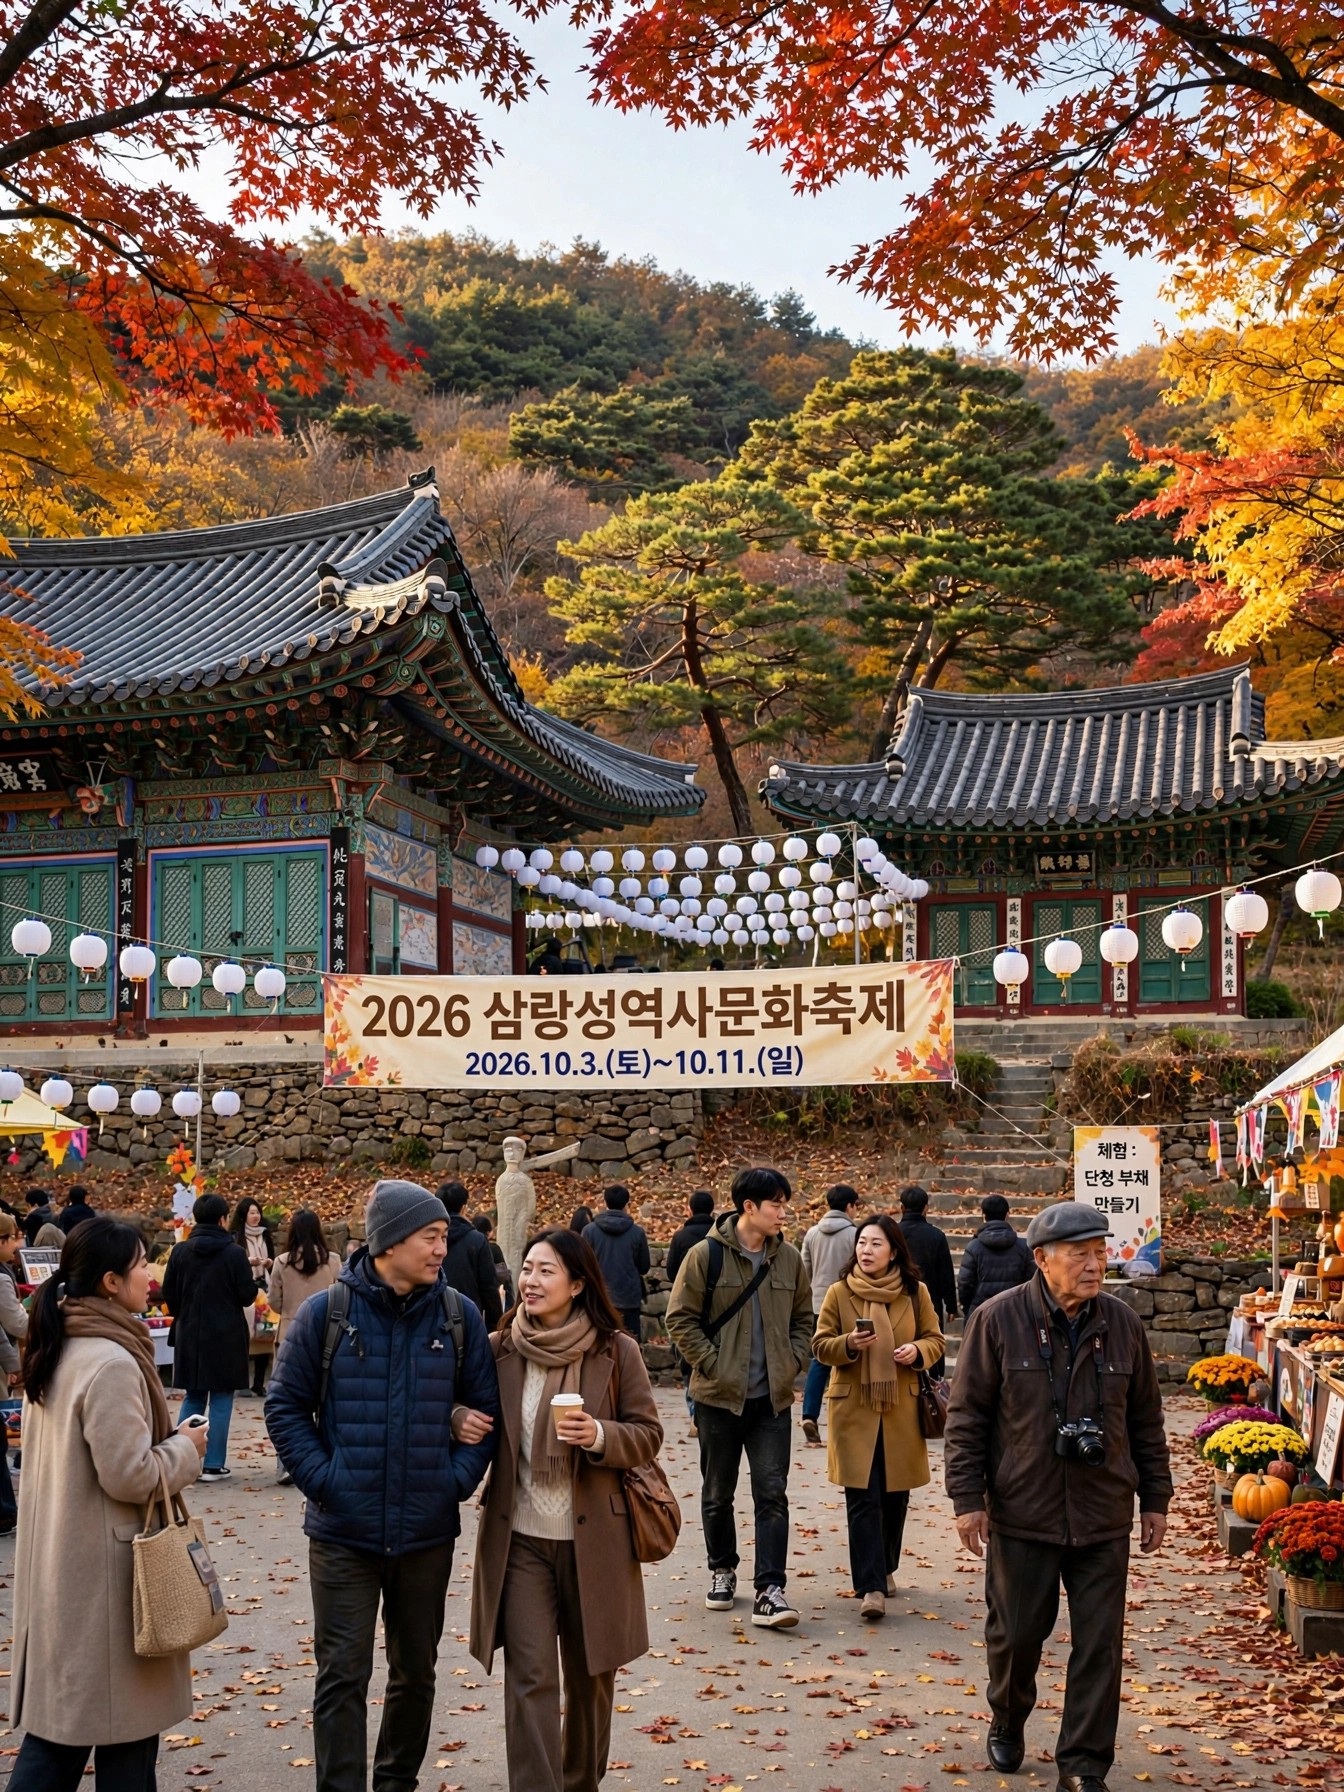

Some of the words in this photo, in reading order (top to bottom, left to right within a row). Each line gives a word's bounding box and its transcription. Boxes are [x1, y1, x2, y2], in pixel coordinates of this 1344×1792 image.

[361, 994, 471, 1038] 2026
[483, 979, 906, 1040] 삼랑성역사문화축제
[465, 1045, 804, 1079] 2026.10.3.(토)~10.11.(일)
[1097, 1141, 1127, 1160] 체험
[1084, 1169, 1115, 1188] 단청
[1117, 1169, 1149, 1187] 부채
[1094, 1195, 1140, 1214] 만들기
